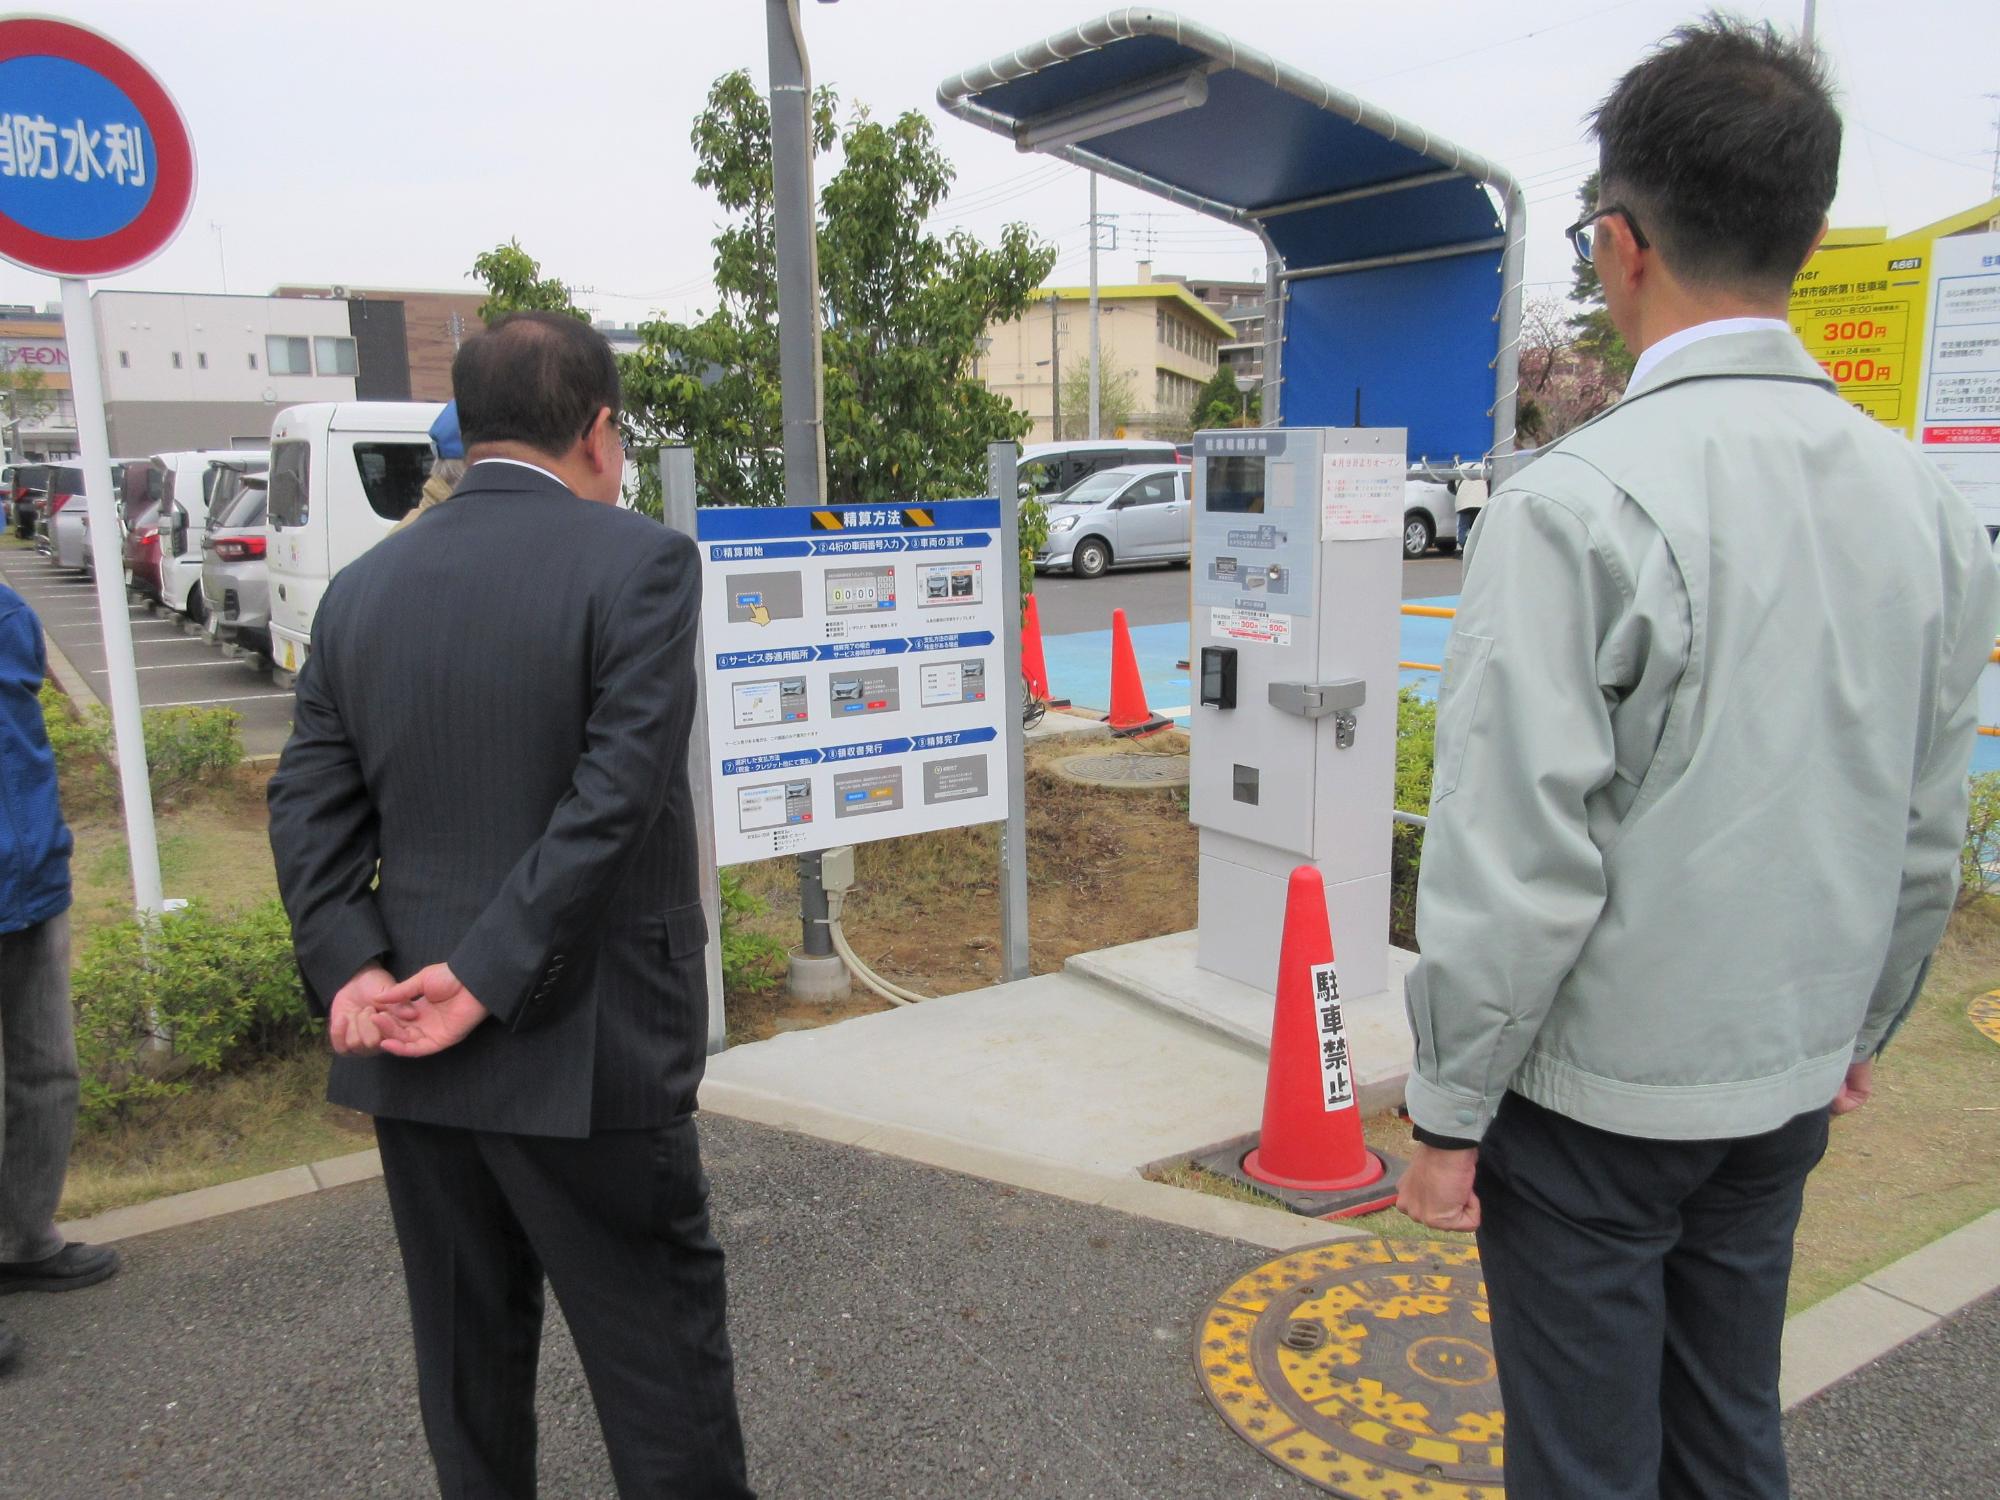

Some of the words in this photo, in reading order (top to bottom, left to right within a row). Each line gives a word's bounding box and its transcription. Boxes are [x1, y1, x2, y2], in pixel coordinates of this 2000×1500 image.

[1823, 320, 1887, 341] 300円
[843, 510, 901, 528] 精算方法
[818, 537, 900, 553] ②4桁の車両番号入力
[911, 536, 965, 549] ③車両の選択
[712, 546, 764, 559] ①精算開始
[718, 649, 809, 667] ④サービス券適用箇所
[1316, 969, 1352, 1105] 駐車禁止
